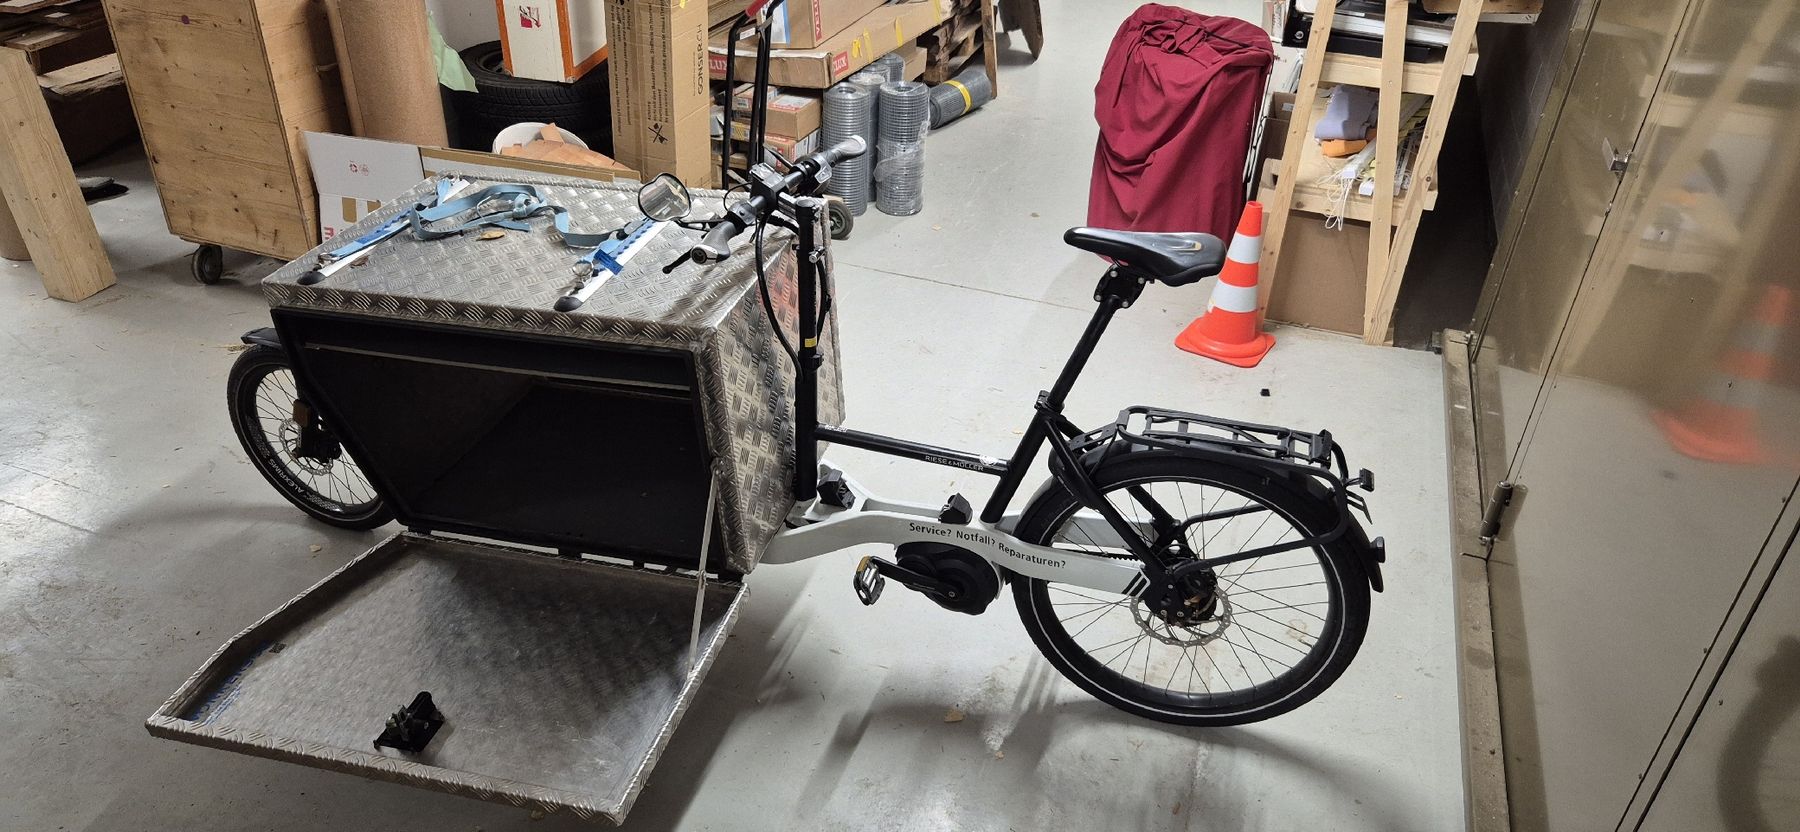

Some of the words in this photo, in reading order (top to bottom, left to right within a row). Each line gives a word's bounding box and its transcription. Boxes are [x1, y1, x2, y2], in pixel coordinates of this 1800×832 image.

[268, 458, 305, 493] ALEXRIMS
[925, 455, 948, 465] RIESE
[909, 522, 952, 537] Service?
[956, 530, 996, 546] Notfall?
[998, 542, 1067, 569] Reparaturen?
